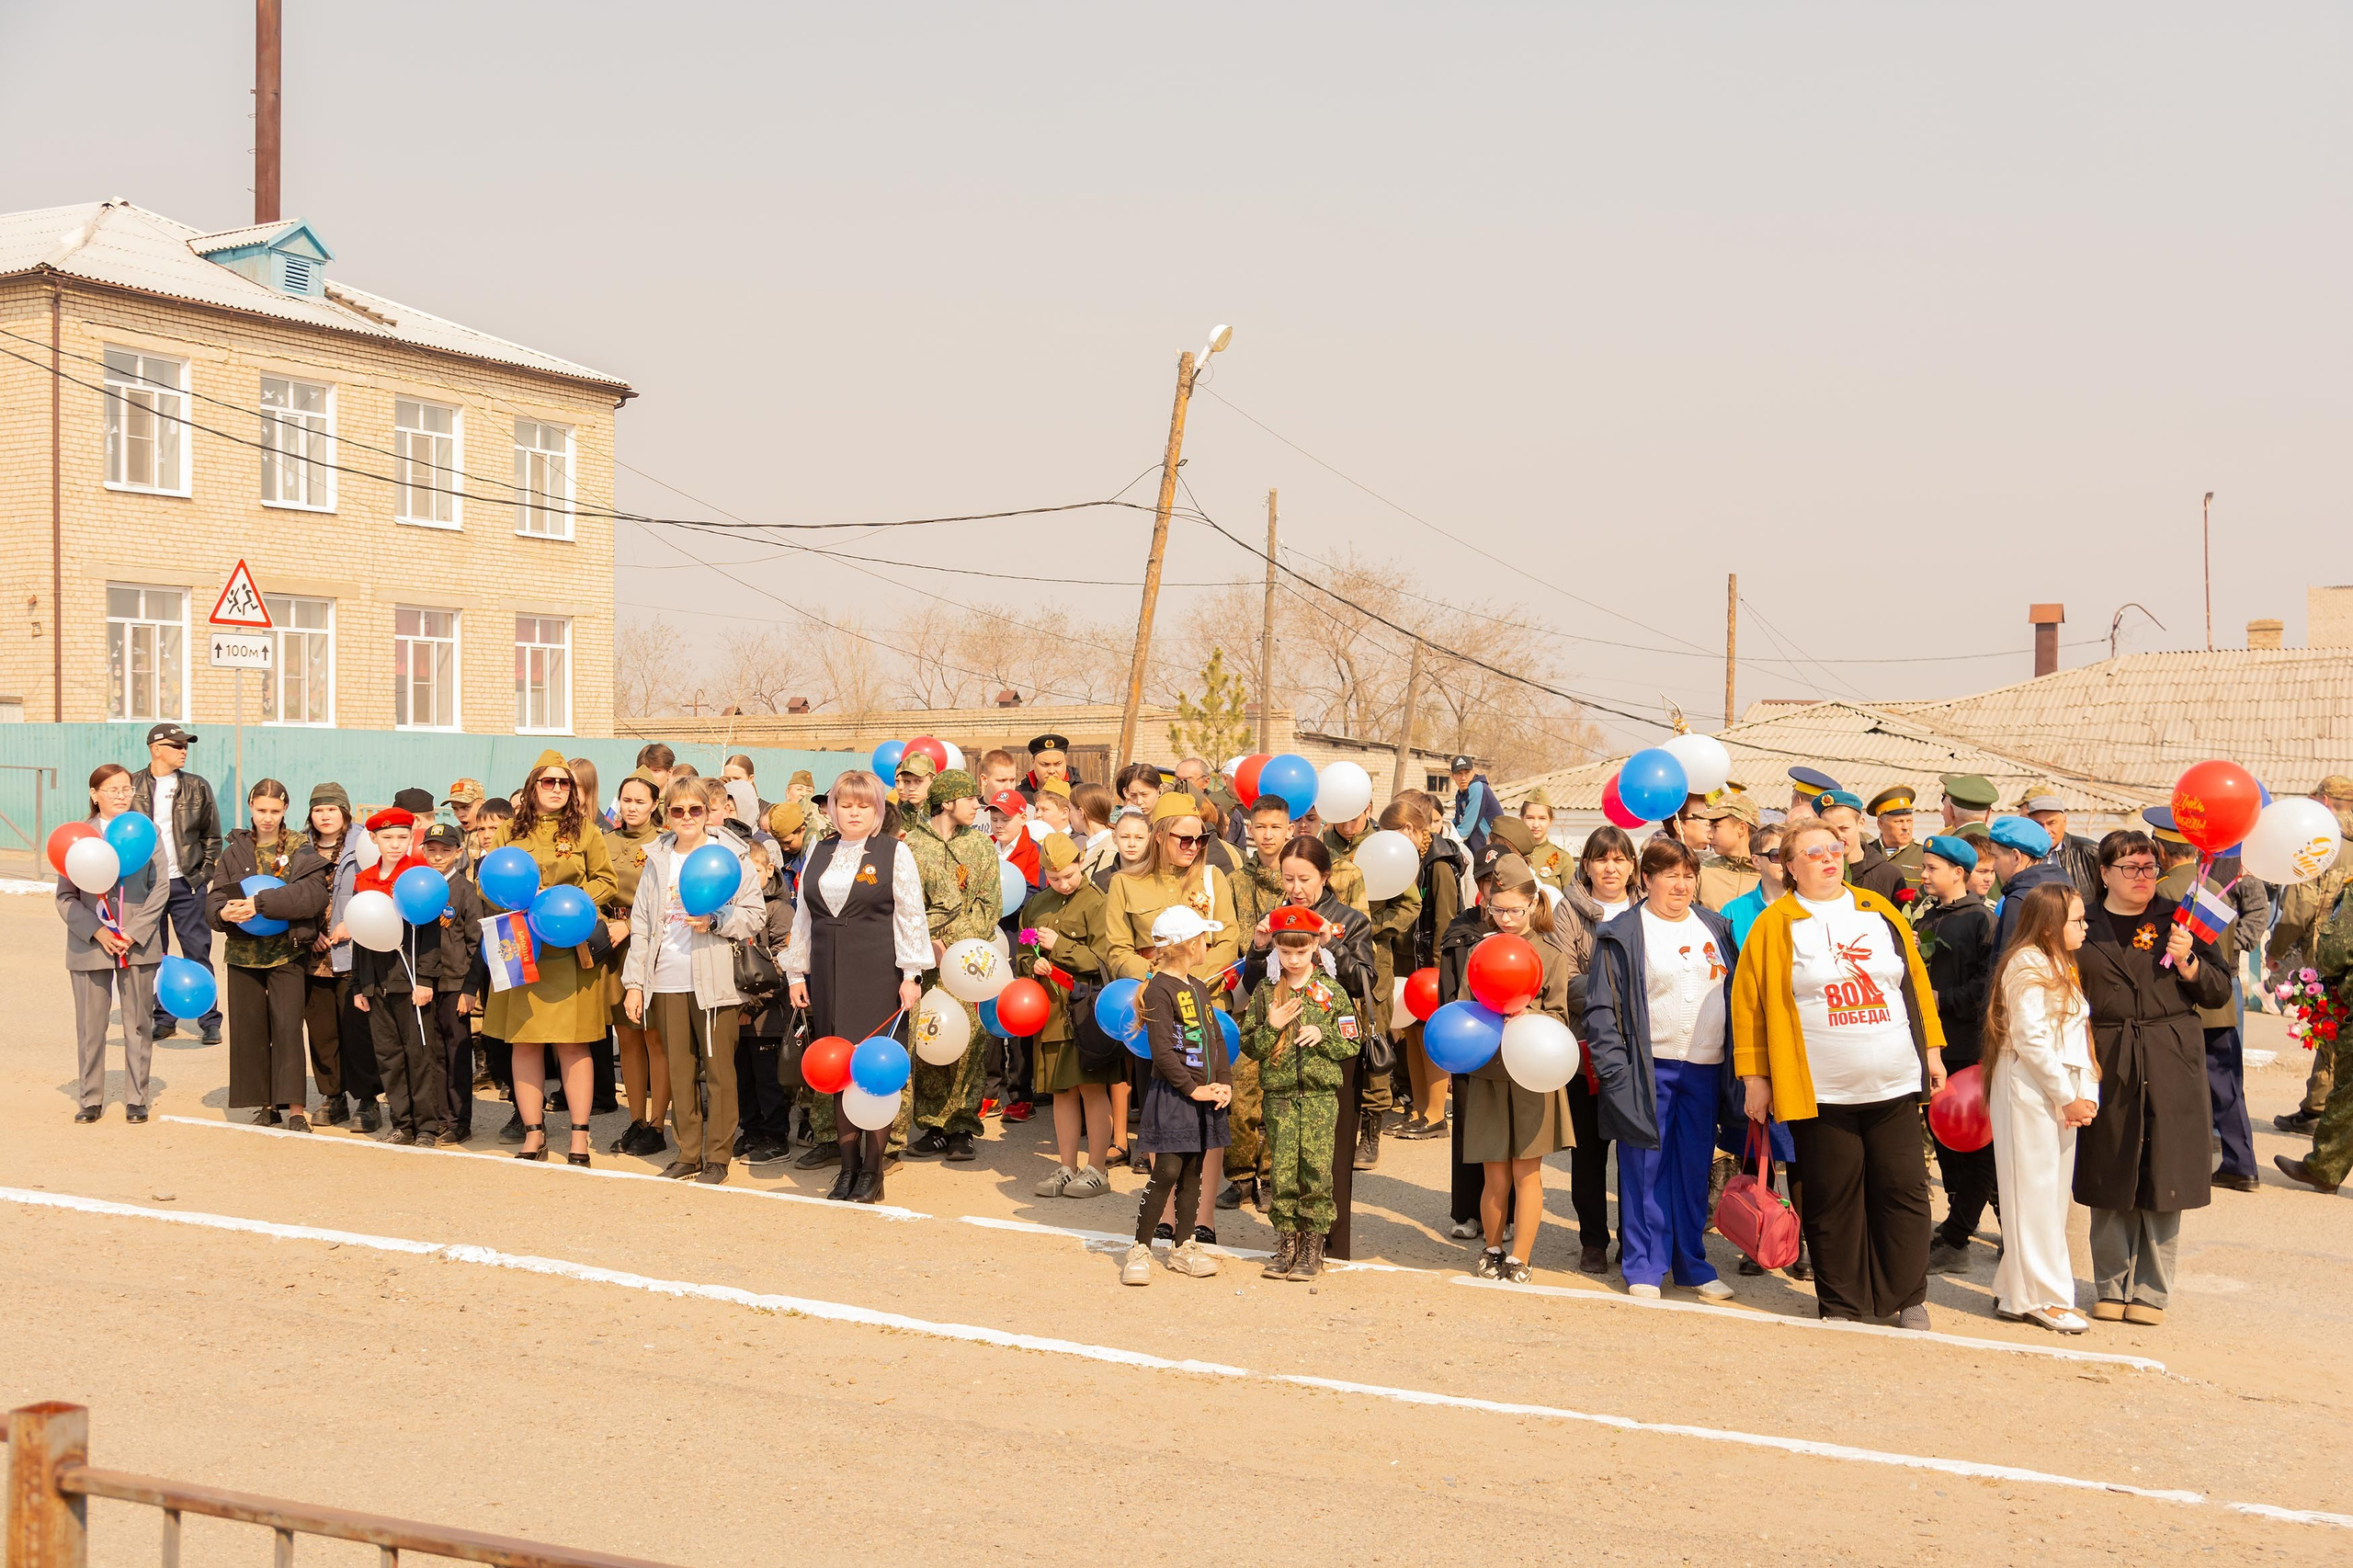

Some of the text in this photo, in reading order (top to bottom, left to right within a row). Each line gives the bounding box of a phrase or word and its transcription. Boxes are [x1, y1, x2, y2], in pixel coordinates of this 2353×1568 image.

[225, 644, 259, 658] 100м
[966, 962, 985, 978] 9
[1824, 982, 1860, 1009] 80
[926, 1016, 938, 1037] 9
[1827, 1008, 1892, 1028] ПОБЕДА!
[1176, 990, 1204, 1068] PLAYER
